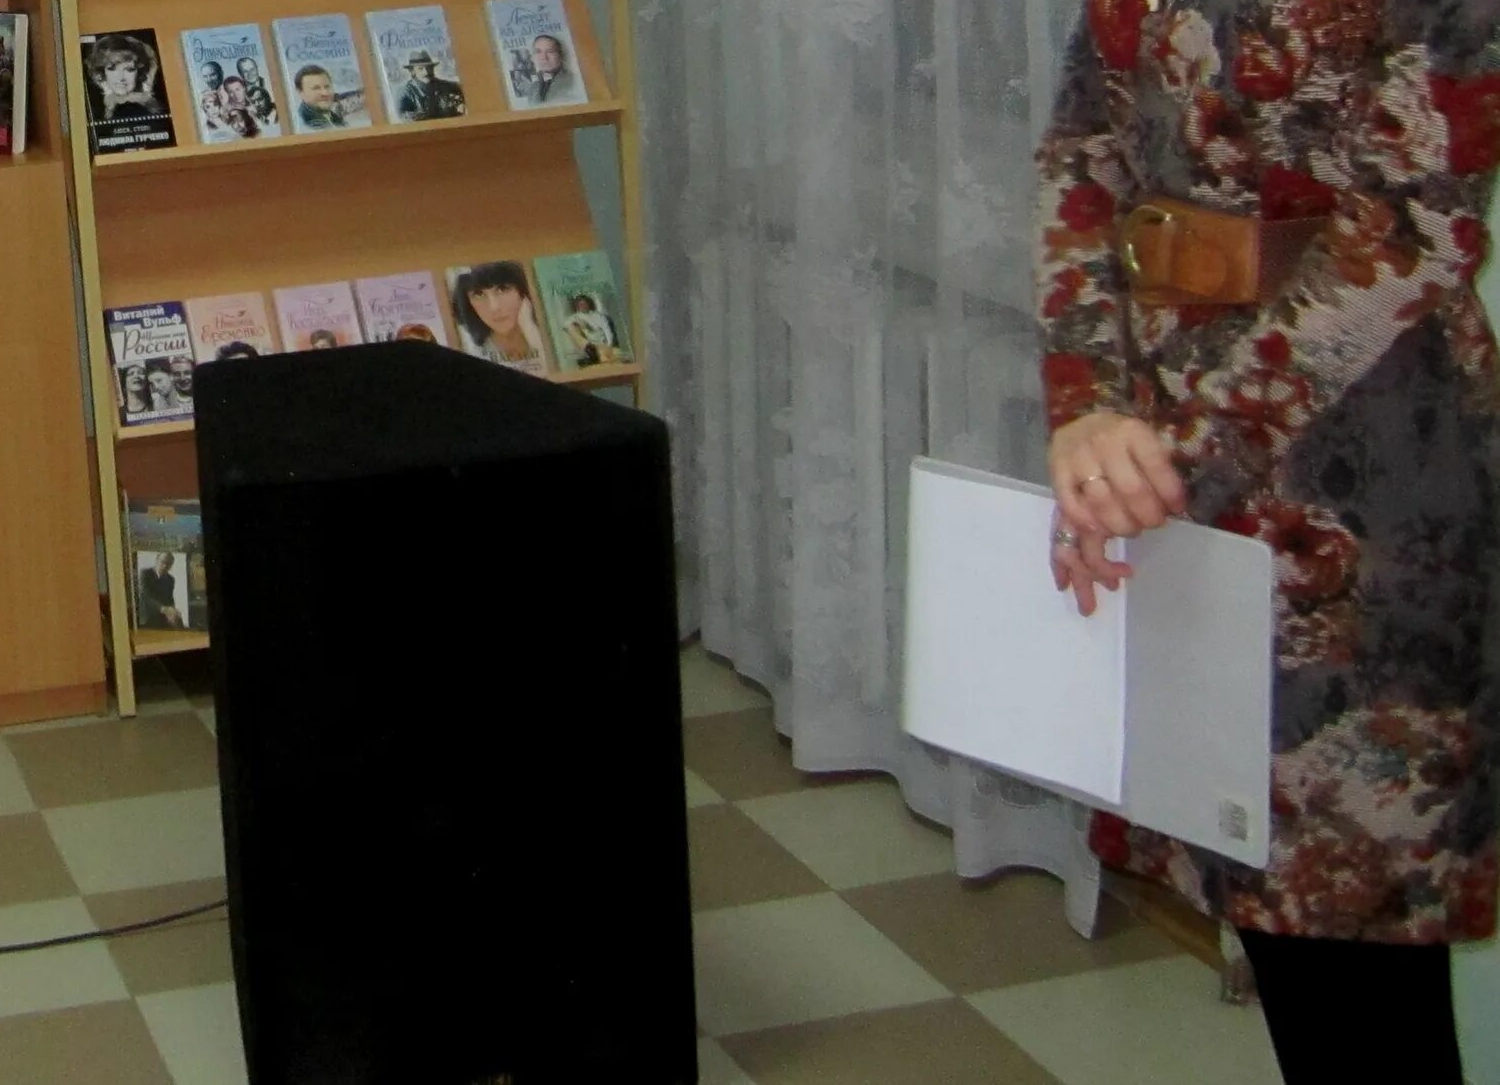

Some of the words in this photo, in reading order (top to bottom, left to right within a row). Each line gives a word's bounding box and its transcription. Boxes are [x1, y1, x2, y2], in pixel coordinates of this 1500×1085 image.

[113, 305, 165, 322] Виталий
[142, 313, 183, 328] Вульф
[122, 330, 188, 361] России
